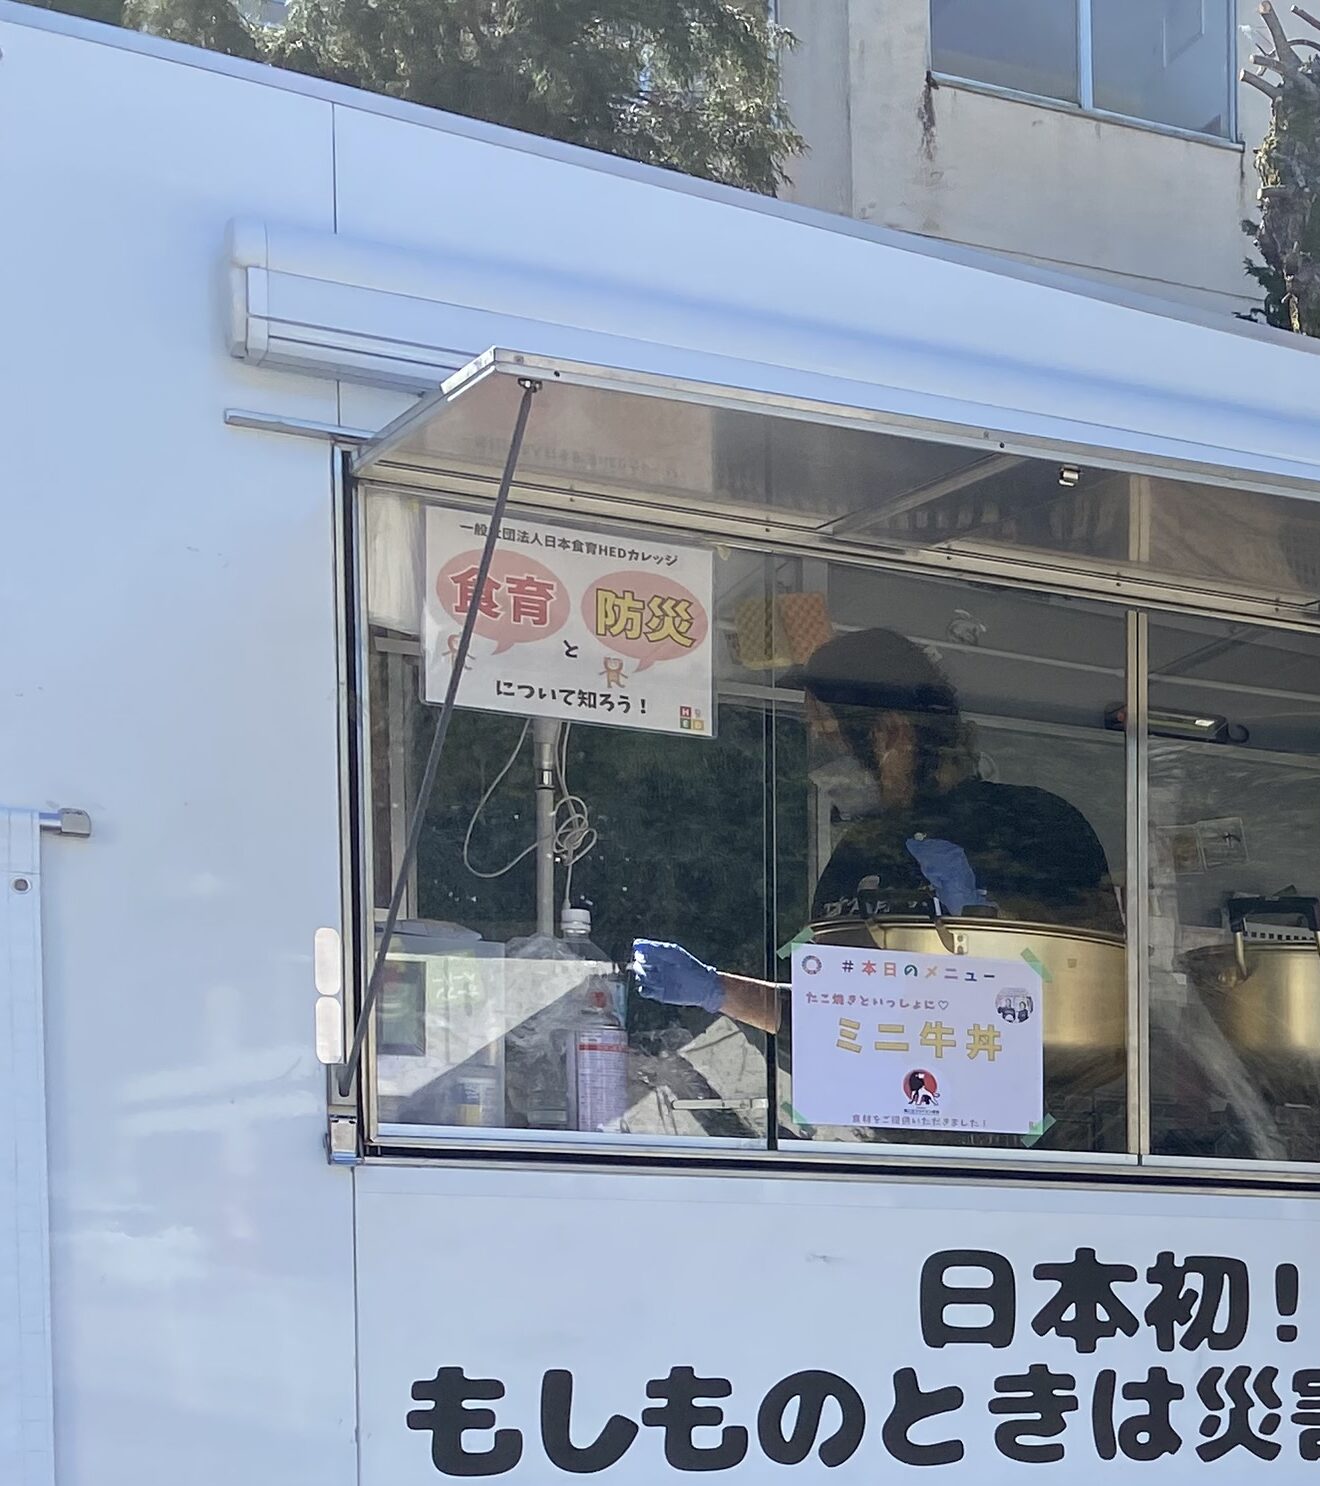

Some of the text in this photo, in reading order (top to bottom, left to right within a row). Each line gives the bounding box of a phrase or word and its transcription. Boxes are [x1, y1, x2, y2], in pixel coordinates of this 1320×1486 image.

[449, 565, 556, 627] 食育
[595, 588, 697, 648] 防災
[562, 640, 579, 659] と
[496, 679, 648, 715] について知ろう！
[842, 960, 995, 982] #本日のメニュー
[836, 1017, 1002, 1061] ミニ牛丼
[918, 1247, 1300, 1354] 日本初!
